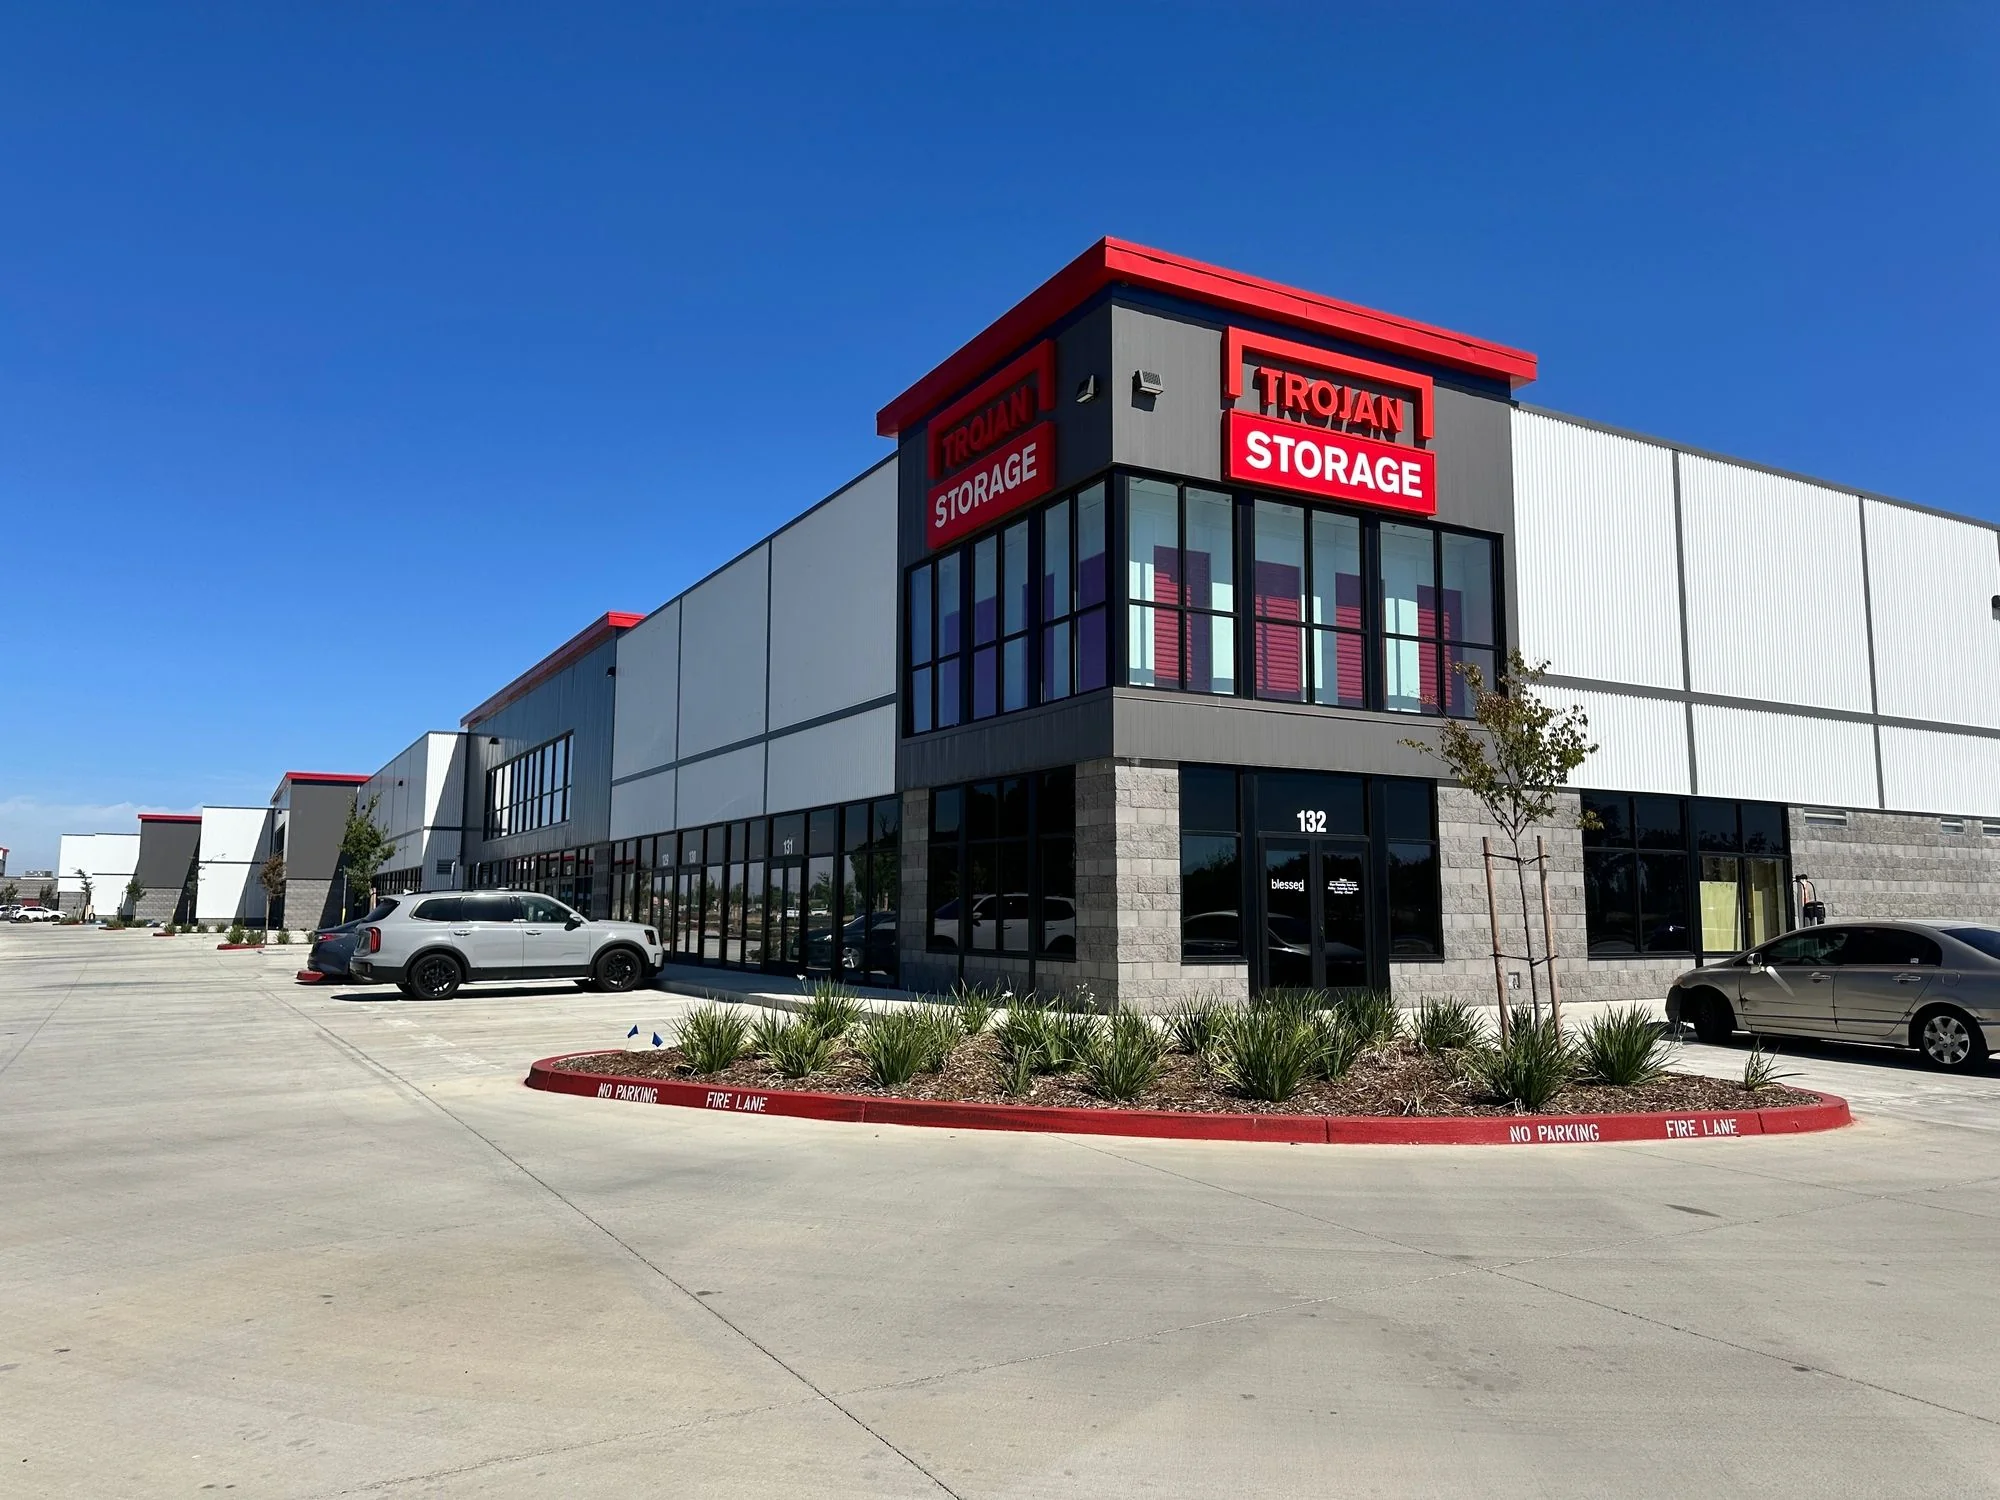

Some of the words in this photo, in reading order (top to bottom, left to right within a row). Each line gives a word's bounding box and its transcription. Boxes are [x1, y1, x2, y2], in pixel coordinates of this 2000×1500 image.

[1257, 366, 1404, 432] TROJAN
[943, 385, 1031, 468] TROJAN
[1245, 430, 1423, 498] STORAGE
[935, 442, 1037, 528] STORAGE
[1296, 810, 1327, 833] 132
[783, 839, 793, 855] 131
[1271, 878, 1305, 891] blessed
[597, 1082, 612, 1098] NO
[615, 1084, 658, 1104] PARKING
[705, 1091, 732, 1109] FIRE
[735, 1095, 768, 1112] LANE
[1509, 1126, 1531, 1142] NO
[1537, 1124, 1599, 1142] PARKING
[1665, 1119, 1698, 1137] FIRE
[1703, 1118, 1739, 1136] LANE
